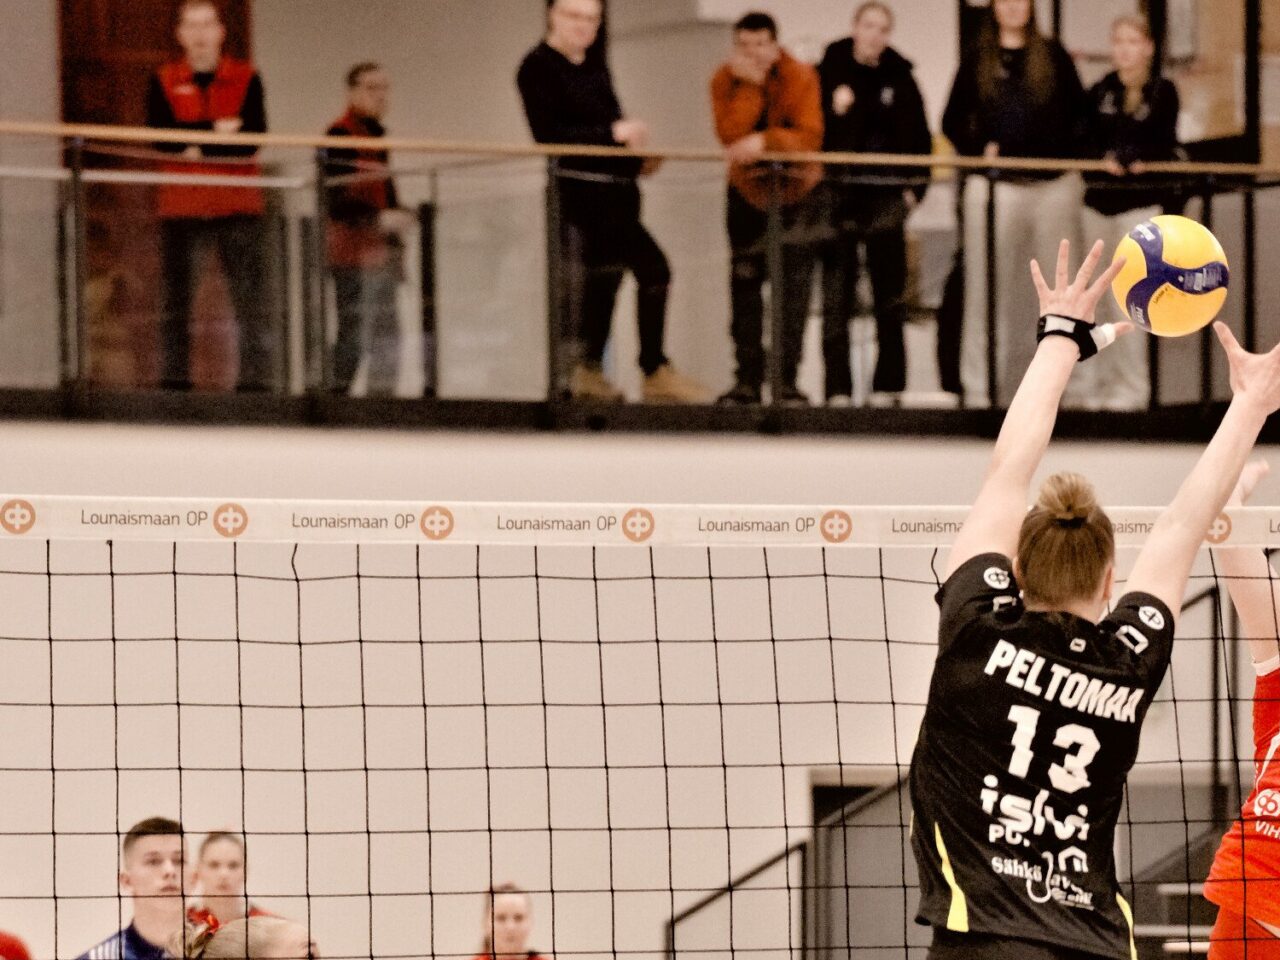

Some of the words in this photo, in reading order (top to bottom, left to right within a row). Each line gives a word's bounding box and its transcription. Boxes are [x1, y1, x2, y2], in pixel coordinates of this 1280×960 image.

[81, 509, 180, 526] Lounaismaan
[186, 511, 208, 526] OP
[291, 513, 388, 528] Lounaismaan
[394, 514, 415, 529] OP
[497, 515, 591, 530] Lounaismaan
[596, 516, 617, 530] OP
[698, 517, 789, 532] Lounaismaan
[795, 518, 815, 532] OP
[1007, 704, 1101, 793] 13
